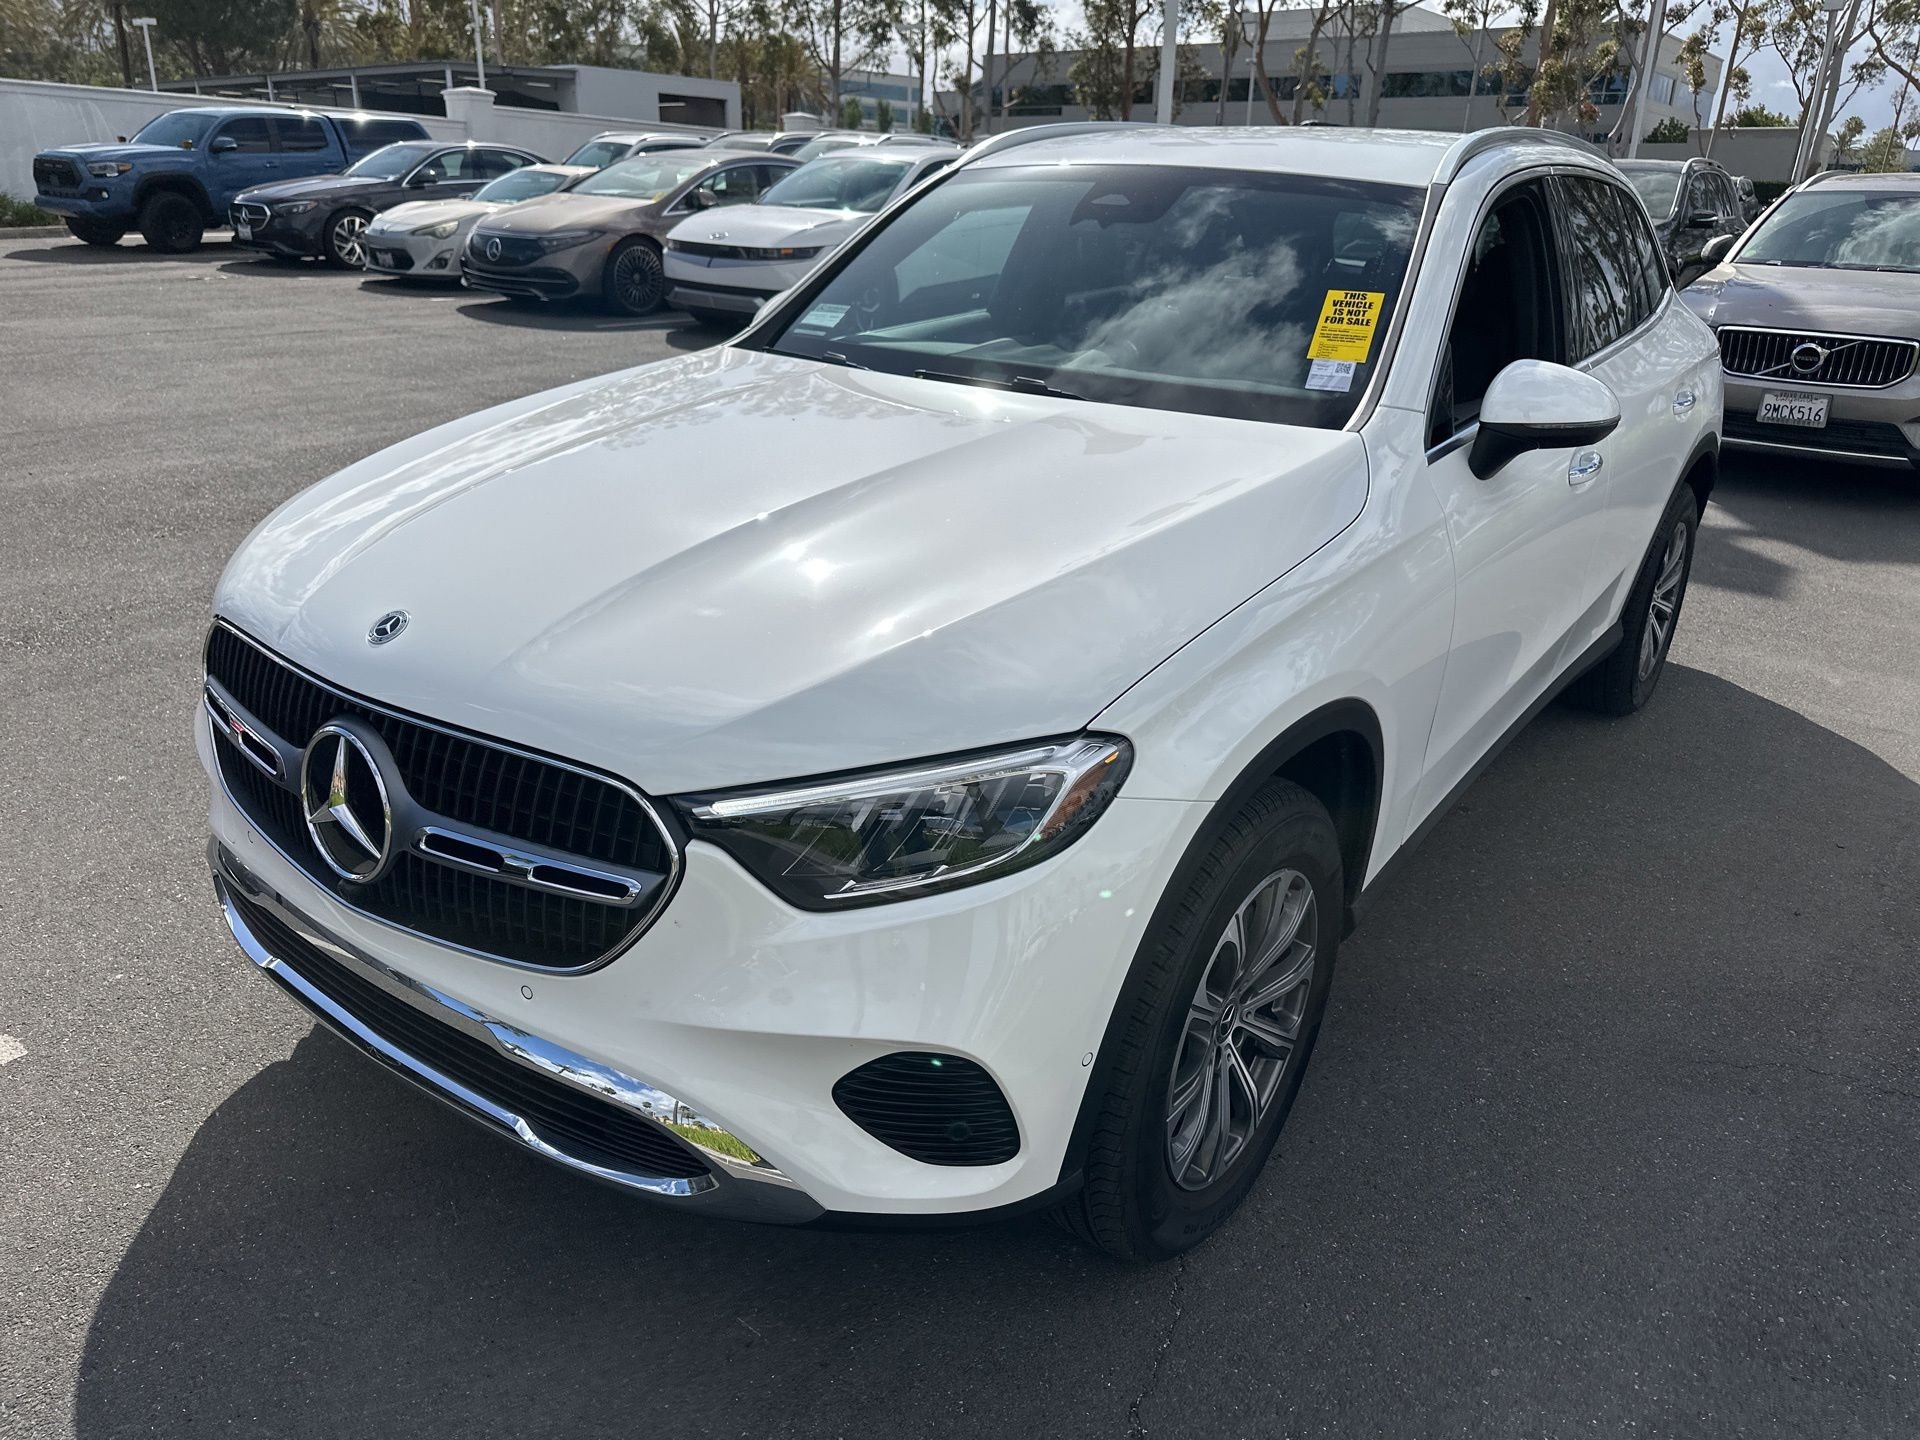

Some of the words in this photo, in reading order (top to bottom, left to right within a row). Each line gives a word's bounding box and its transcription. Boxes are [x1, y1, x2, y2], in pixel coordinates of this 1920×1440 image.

[1344, 292, 1367, 300] THIS
[1332, 299, 1374, 309] VEHICLE
[1333, 308, 1344, 316] IS
[1346, 309, 1368, 317] NOT
[1324, 316, 1344, 324] FOR
[1346, 317, 1372, 326] SALE
[1763, 403, 1824, 422] 9MCK516
